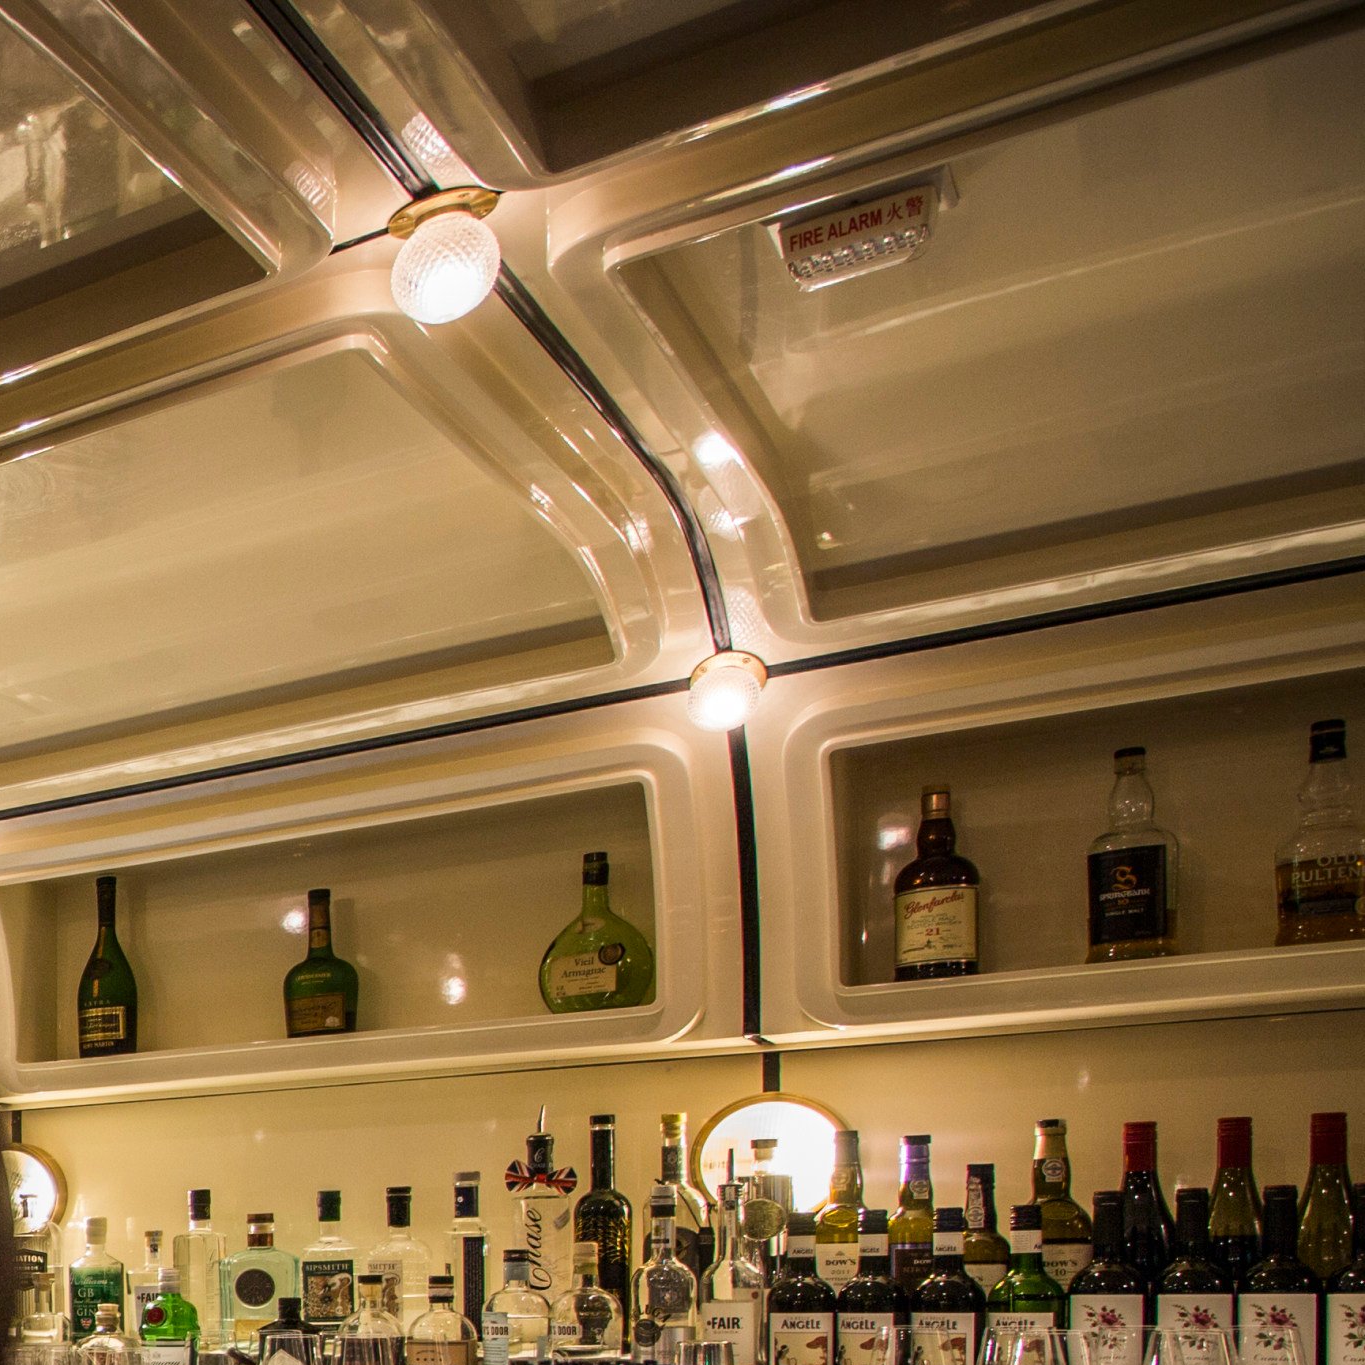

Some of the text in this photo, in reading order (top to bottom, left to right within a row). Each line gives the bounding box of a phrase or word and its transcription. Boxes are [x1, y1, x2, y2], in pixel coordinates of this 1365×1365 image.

[885, 195, 923, 225] 火警
[790, 208, 882, 253] FIRE ALARM
[904, 890, 965, 920] Glenfarclas
[925, 927, 941, 937] 21
[574, 956, 595, 967] Vieil
[561, 966, 607, 979] Armagnac
[825, 1258, 856, 1267] DOW'S
[1054, 1269, 1066, 1277] 10
[77, 1288, 95, 1299] GB
[76, 1307, 97, 1317] GIN
[711, 1316, 741, 1330] FAIR
[491, 1325, 509, 1336] DOOR
[558, 1325, 577, 1336] DOOR
